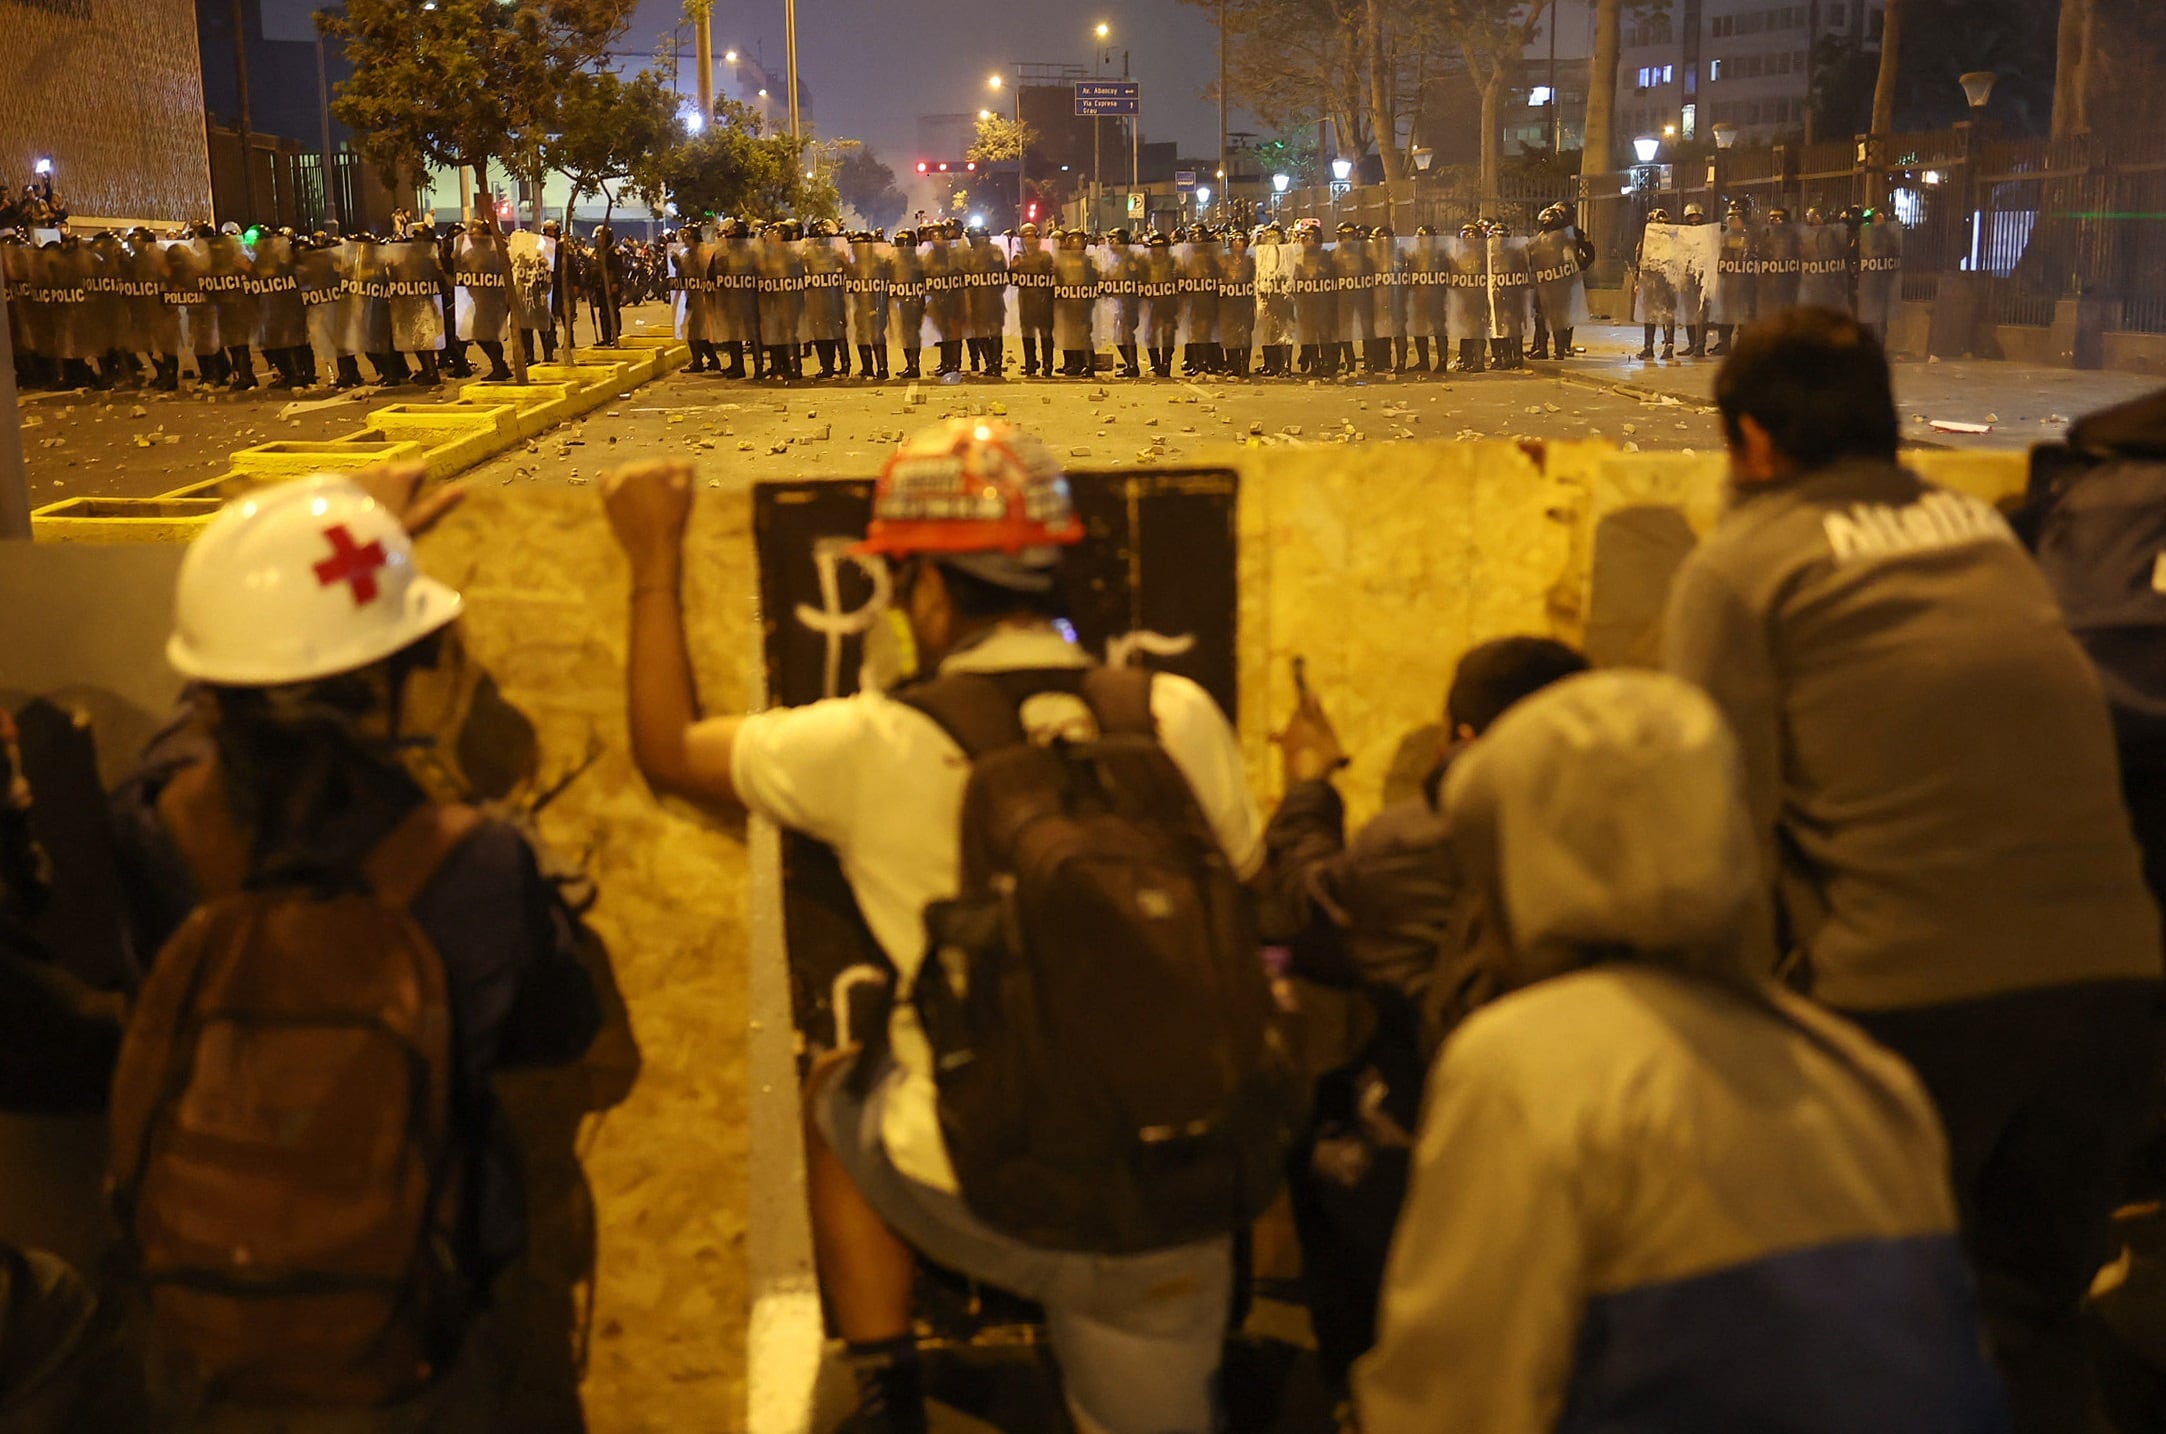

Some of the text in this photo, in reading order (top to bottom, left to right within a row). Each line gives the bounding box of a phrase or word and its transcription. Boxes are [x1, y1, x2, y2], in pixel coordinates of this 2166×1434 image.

[1536, 261, 1580, 283] POLICIA
[1761, 259, 1799, 273] POLICI
[1801, 258, 1847, 275] POLICIA
[243, 275, 296, 294] POLICIA
[455, 272, 505, 287] POLICIA
[716, 275, 756, 289] POLICI
[758, 278, 805, 293] POLICIA
[925, 275, 963, 291] POLICI
[964, 271, 1010, 287] POLICIA
[1012, 272, 1057, 288] POLICIA
[1178, 278, 1222, 292] POLICI
[1411, 271, 1449, 286] POLICI
[1452, 273, 1487, 287] POLIC
[340, 279, 391, 299] POLICIA
[389, 281, 440, 296] POLICIA
[1098, 280, 1140, 294] POLICI
[1137, 282, 1177, 297] POLICI
[51, 288, 85, 303] POLIC
[301, 286, 341, 306] POLIC
